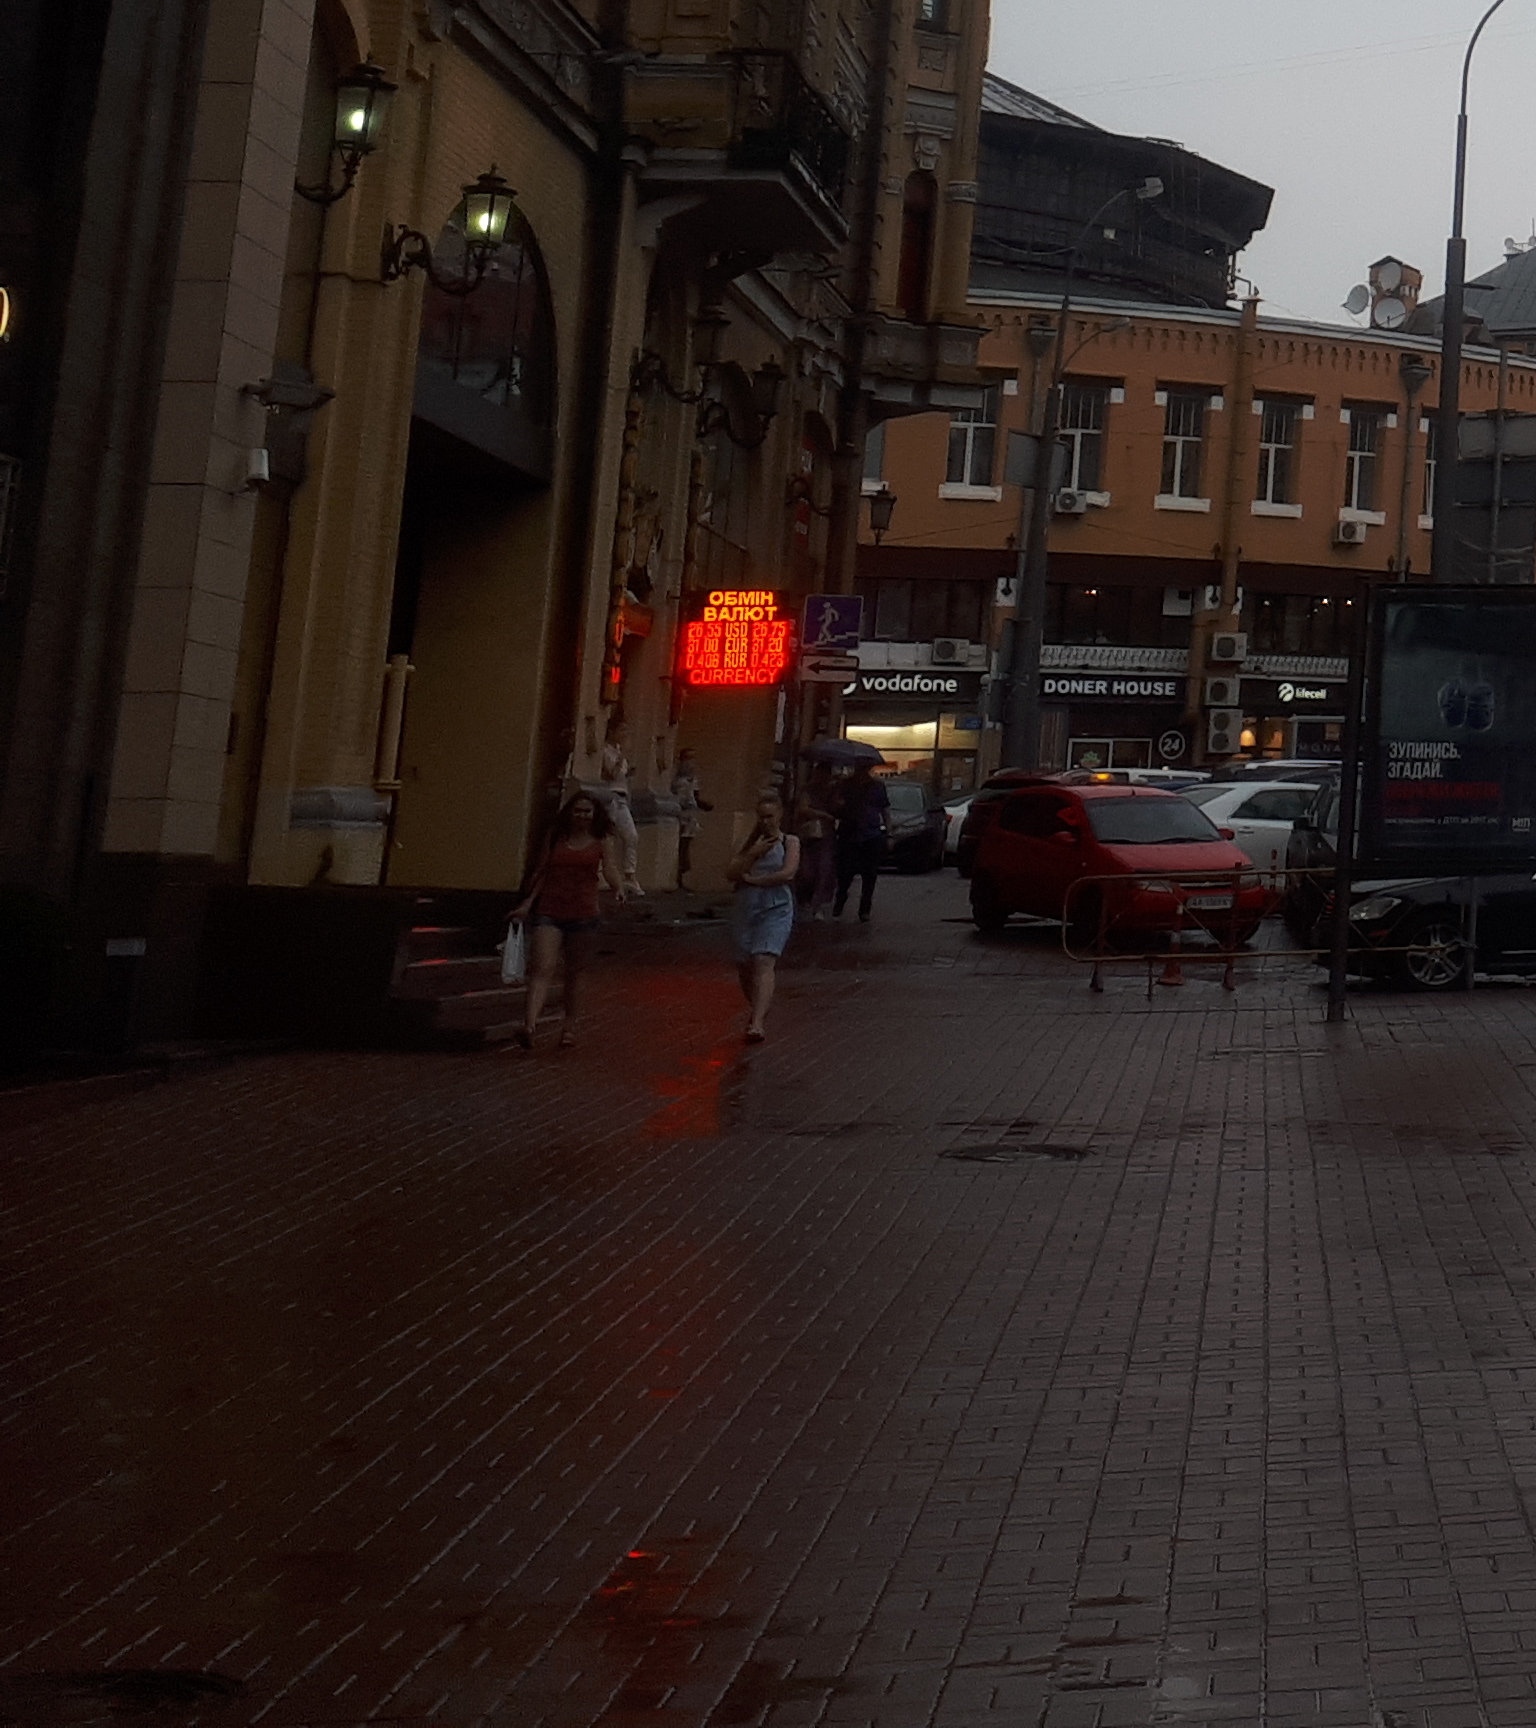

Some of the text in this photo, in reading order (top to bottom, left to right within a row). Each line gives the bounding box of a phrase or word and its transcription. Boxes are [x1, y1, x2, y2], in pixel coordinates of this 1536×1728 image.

[709, 590, 774, 606] ОБМІН
[703, 606, 778, 622] ВАЛЮТ
[725, 622, 748, 638] USD
[725, 638, 748, 653] EUR
[723, 653, 747, 668] RUR
[689, 668, 777, 685] CURRENCY
[861, 674, 958, 693] vodafone
[1043, 678, 1177, 696] DONER HOUSE
[1161, 735, 1181, 753] 24
[1388, 741, 1462, 760] ЗУПИНИСЬ.
[1387, 759, 1445, 780] ЗГАДАЙ.
